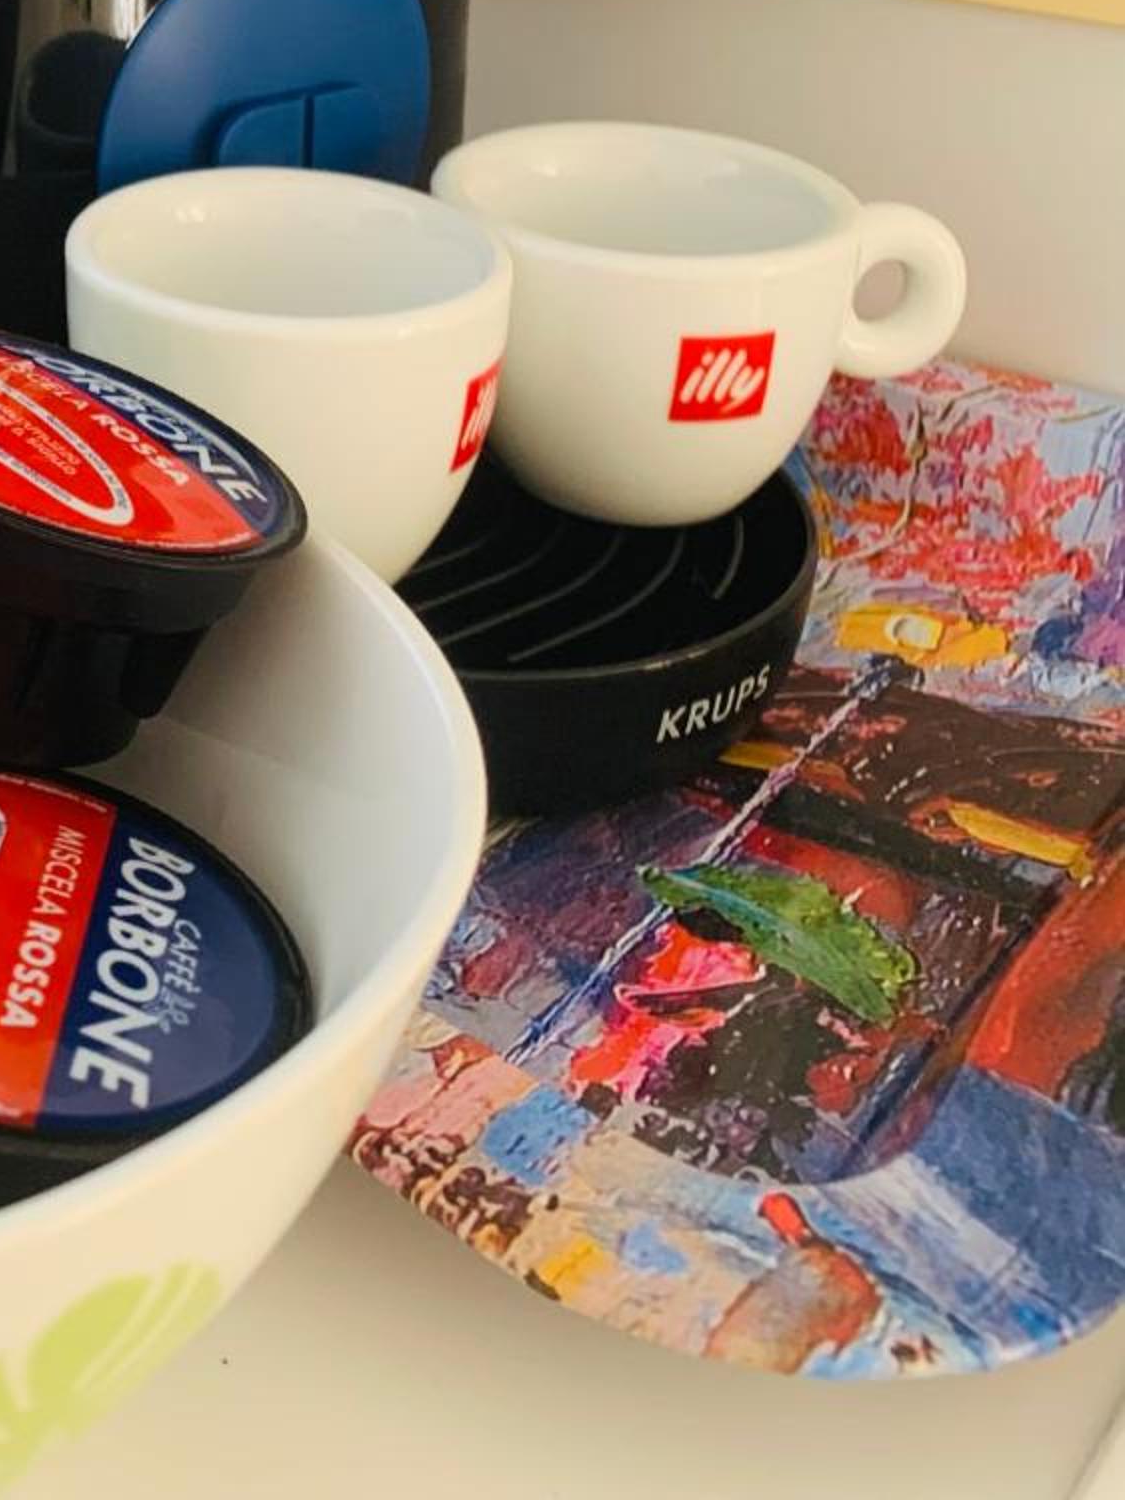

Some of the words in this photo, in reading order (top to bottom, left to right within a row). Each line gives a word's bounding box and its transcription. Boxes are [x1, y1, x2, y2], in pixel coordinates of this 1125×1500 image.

[460, 376, 498, 450] ill
[680, 348, 765, 414] illy
[90, 411, 190, 486] ROSSA
[655, 664, 771, 744] KRUPS
[31, 824, 87, 917] MISCELA
[69, 836, 196, 1110] BORBONE
